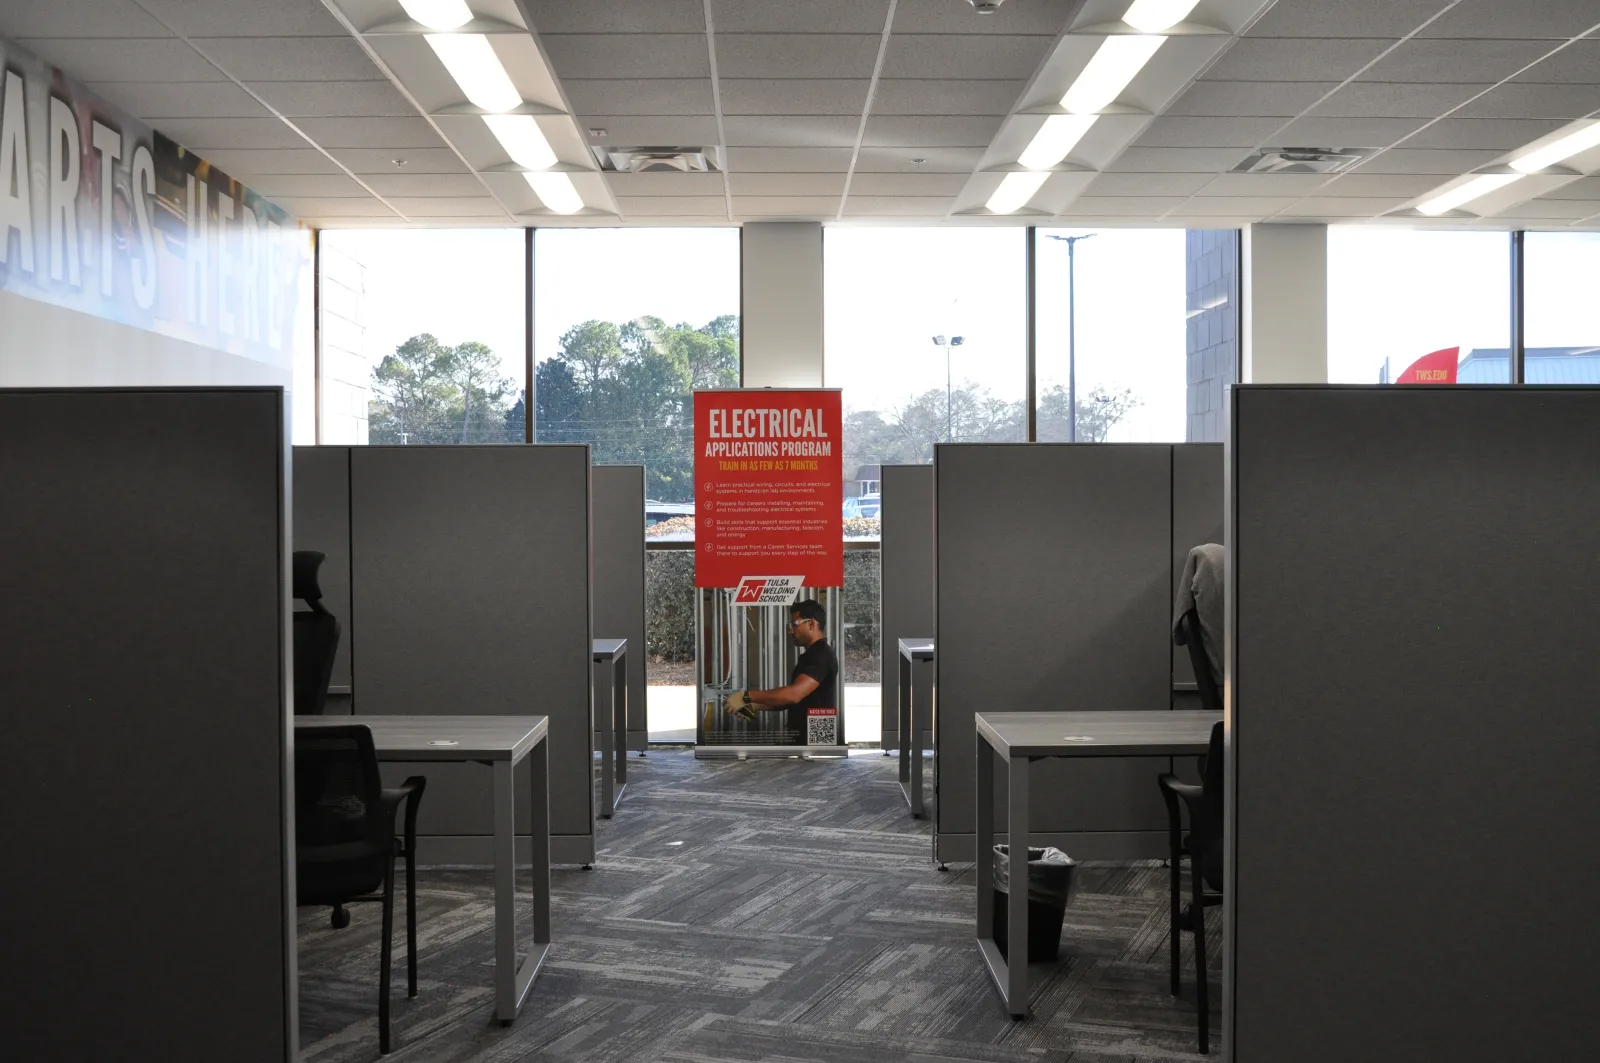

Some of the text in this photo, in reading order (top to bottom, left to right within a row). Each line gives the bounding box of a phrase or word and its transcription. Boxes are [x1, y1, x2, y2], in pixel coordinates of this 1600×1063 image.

[1416, 370, 1448, 381] TWS.EDU
[709, 408, 828, 438] ELECTRICAL
[705, 441, 831, 457] APPLICATIONS PROGRAM
[719, 460, 818, 471] TRAIN IN AS FEW AS 7 MONTHS
